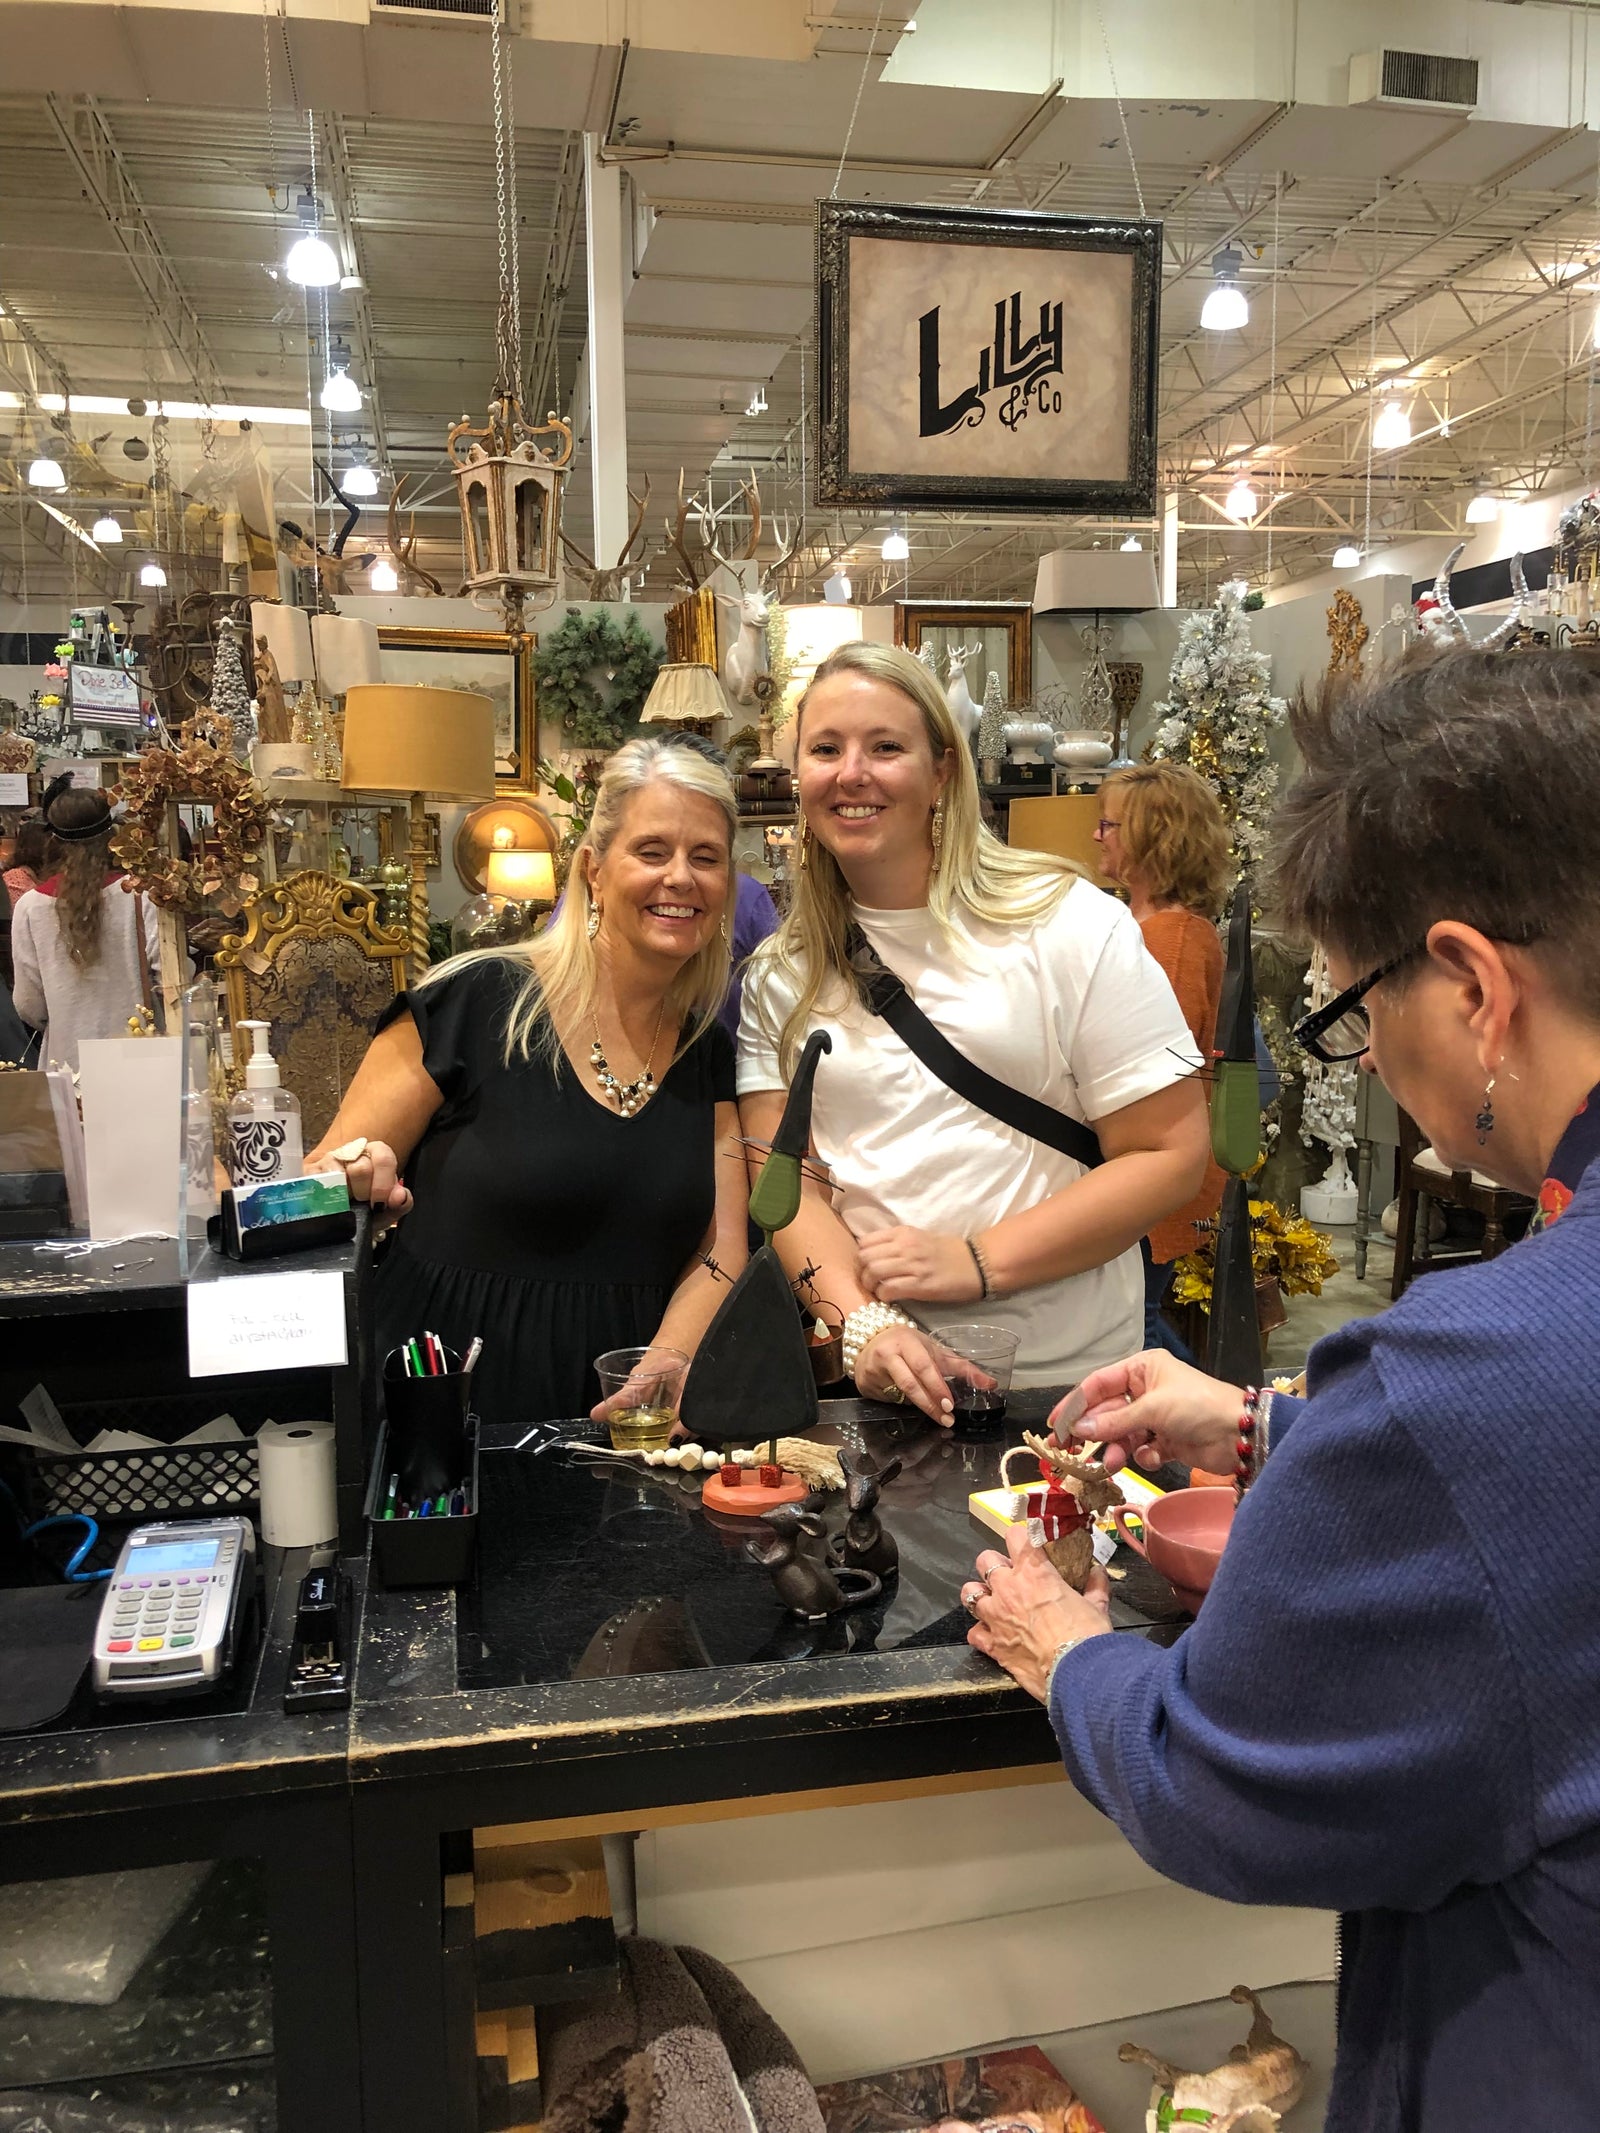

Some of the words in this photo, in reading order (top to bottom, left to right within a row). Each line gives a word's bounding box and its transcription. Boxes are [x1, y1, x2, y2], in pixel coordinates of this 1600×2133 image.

[999, 385, 1028, 433] &
[1038, 380, 1062, 414] Co
[79, 671, 106, 688] Dixie
[109, 674, 133, 690] Belle
